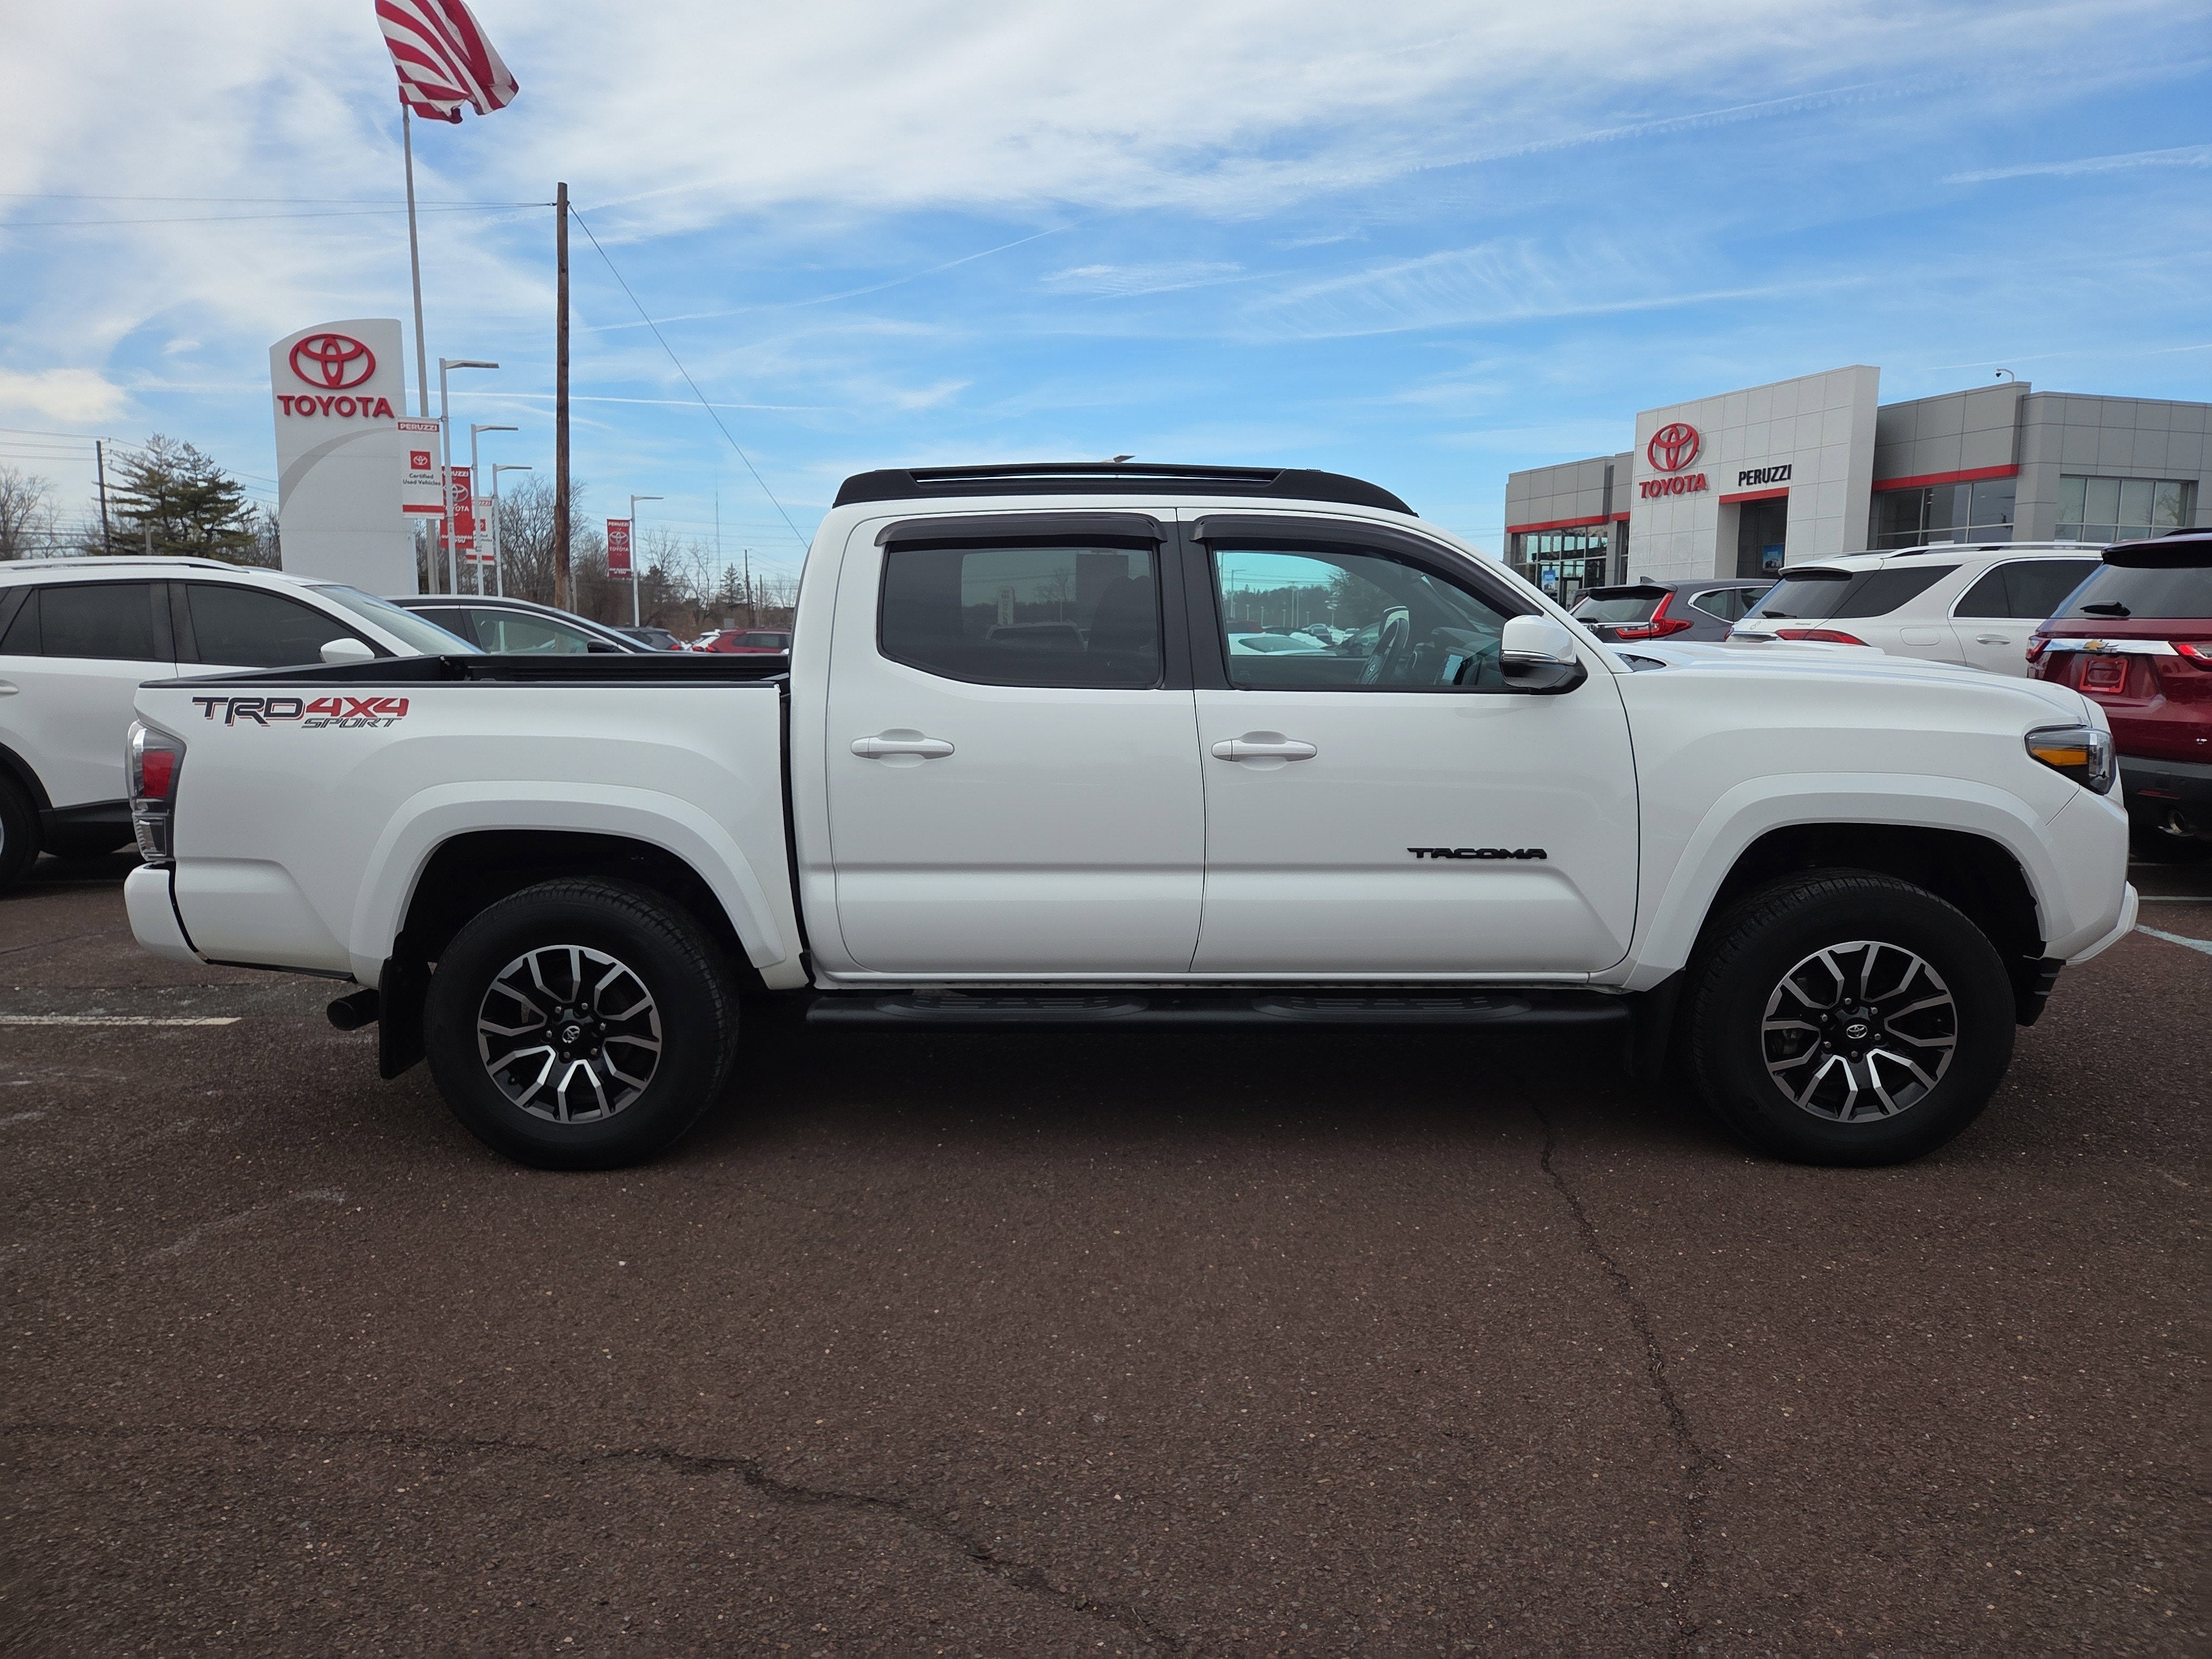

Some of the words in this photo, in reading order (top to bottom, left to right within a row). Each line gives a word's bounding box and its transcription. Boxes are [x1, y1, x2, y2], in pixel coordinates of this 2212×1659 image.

[277, 395, 395, 419] TOYOTA
[1638, 473, 1707, 499] TOYOTA
[1738, 464, 1792, 486] PERUZZI
[301, 717, 403, 729] SPORT
[1407, 848, 1547, 859] TACOMA
